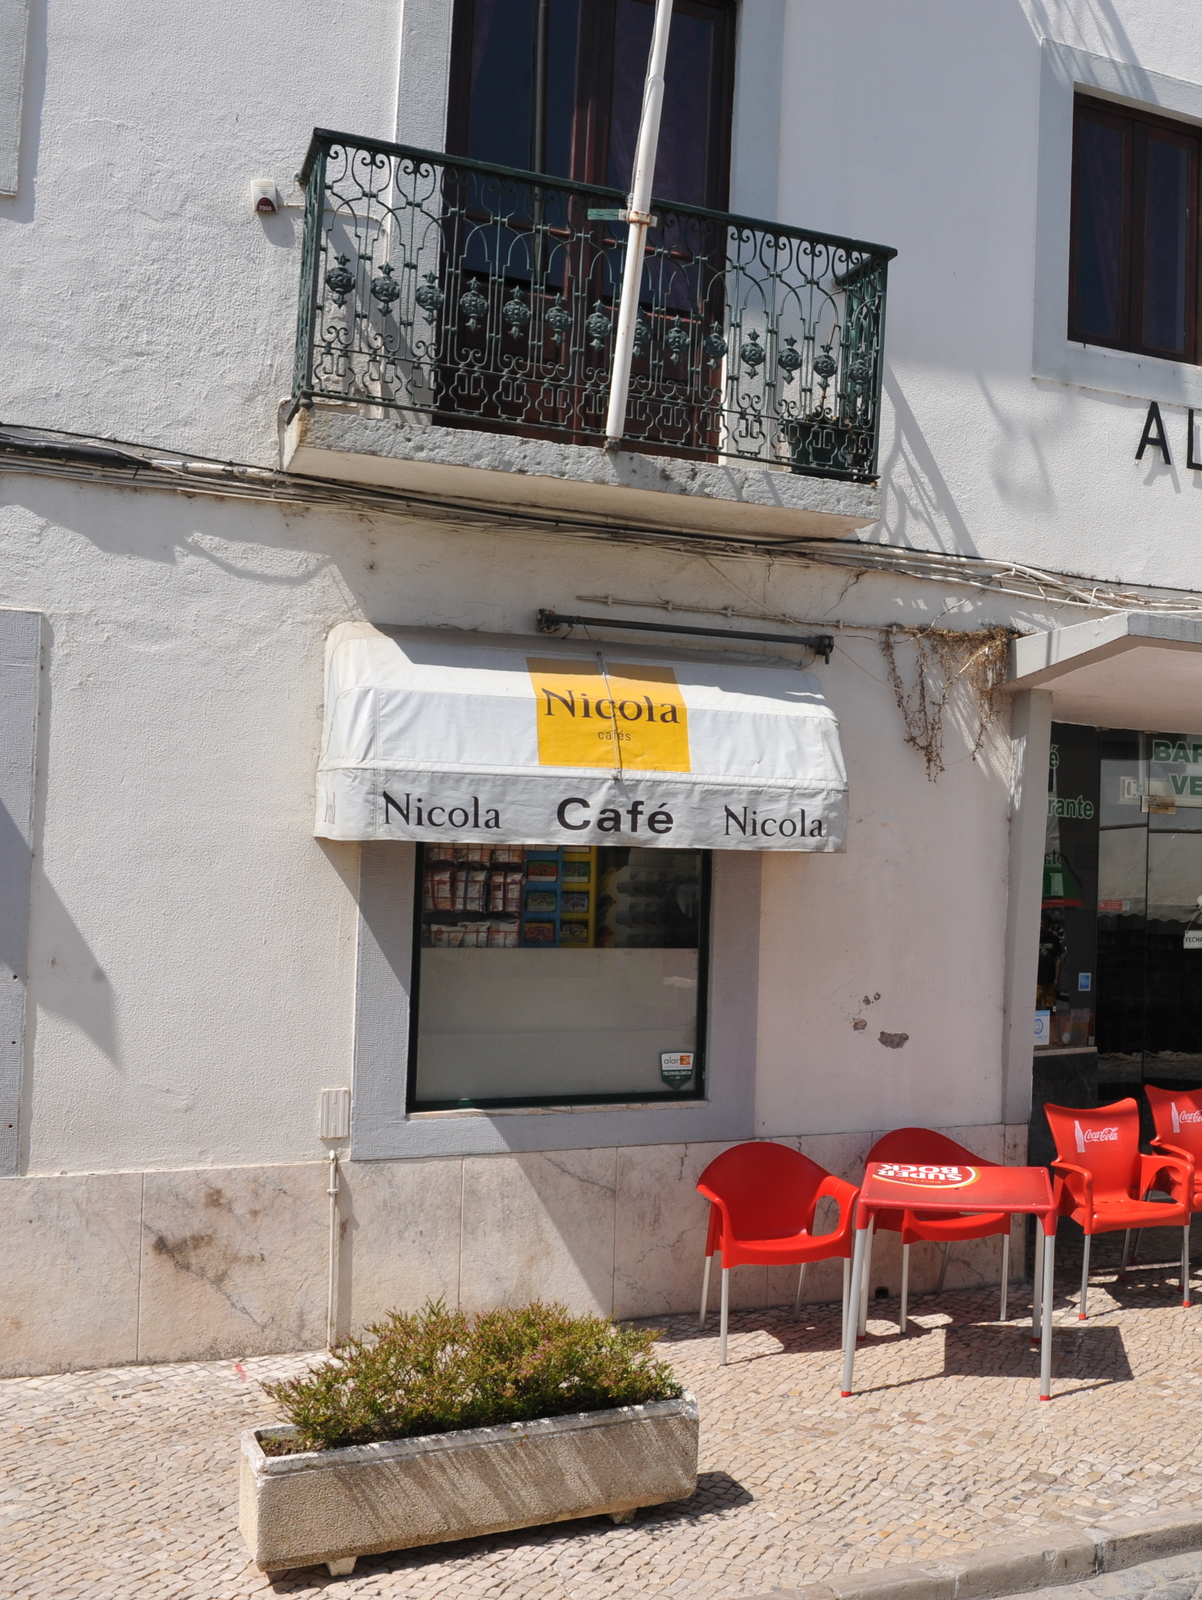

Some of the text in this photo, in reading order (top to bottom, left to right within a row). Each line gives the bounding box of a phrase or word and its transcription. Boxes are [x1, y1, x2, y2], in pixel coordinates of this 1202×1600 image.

[541, 688, 680, 724] Nicola
[383, 790, 826, 838] Nicola Café Nicola
[1084, 1127, 1119, 1142] Coca-Cola
[877, 1169, 963, 1181] SUPER
[880, 1163, 959, 1174] BOCK
